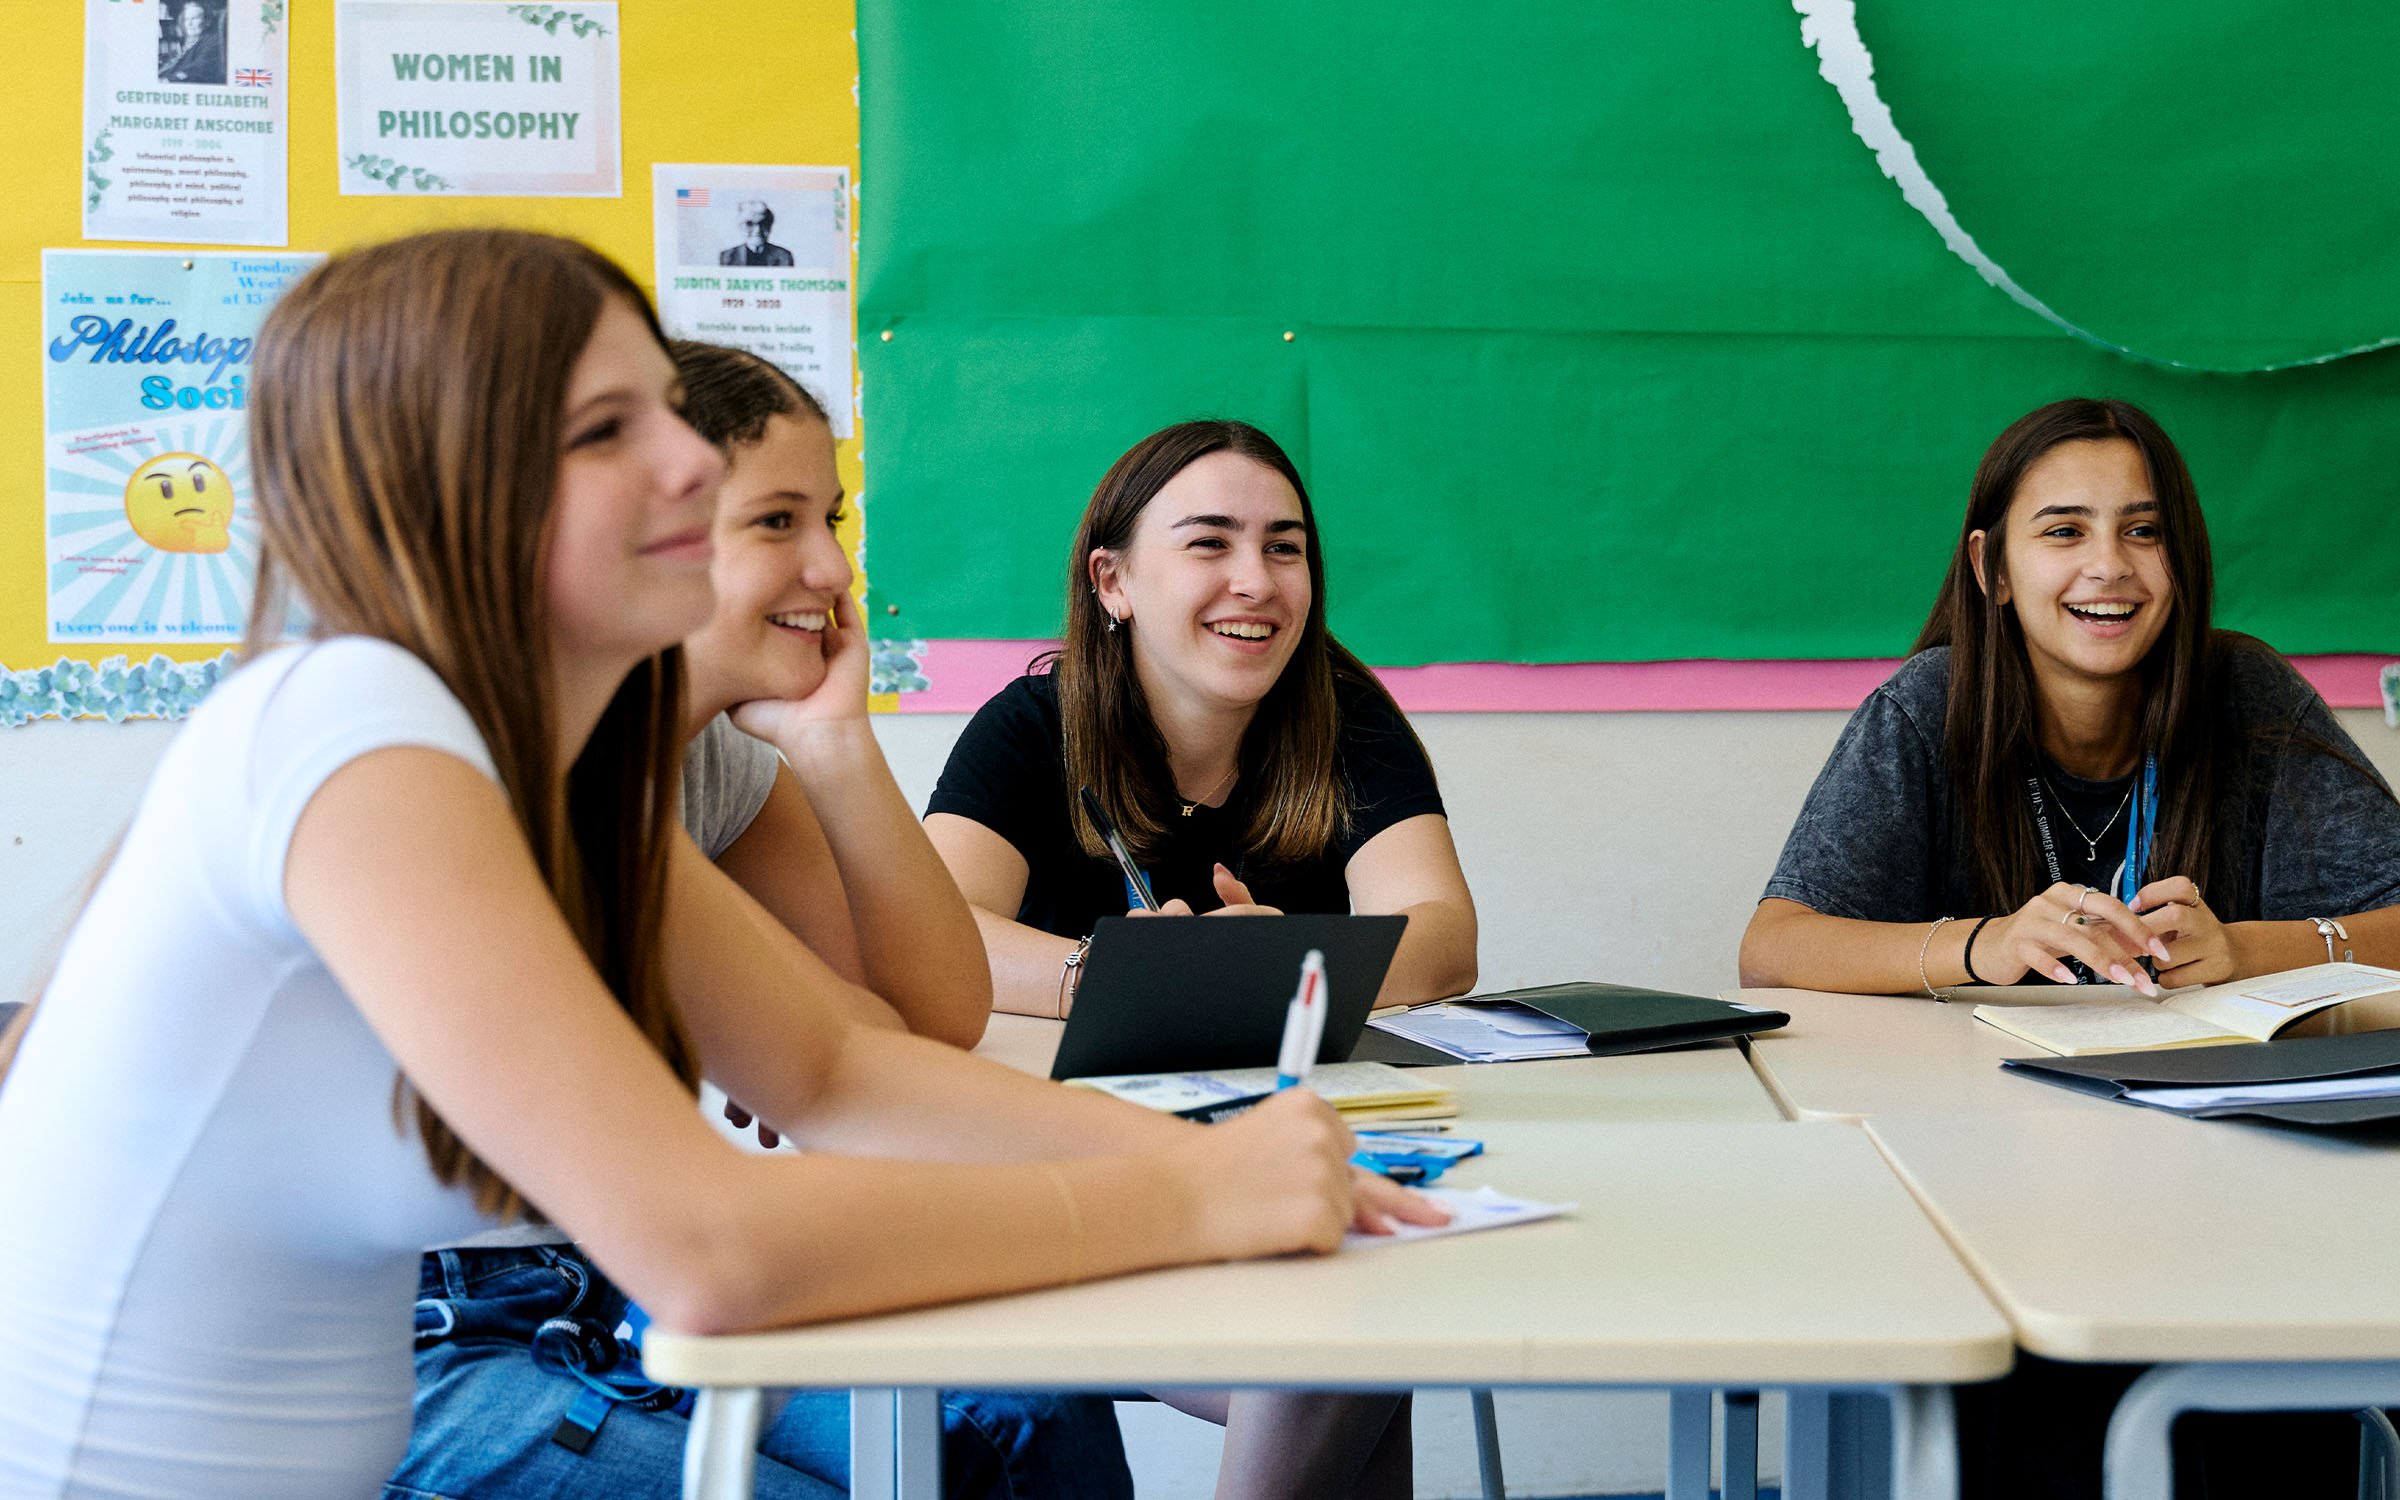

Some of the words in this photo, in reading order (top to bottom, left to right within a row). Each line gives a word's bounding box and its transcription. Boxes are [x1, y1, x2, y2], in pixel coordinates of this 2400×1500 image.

[392, 53, 514, 82] WOMEN
[529, 55, 562, 82] IN
[116, 90, 190, 106] GERTRUDE
[195, 93, 269, 108] ELIZABETH
[111, 116, 189, 131] MARGARET
[195, 119, 274, 134] ANSCOMBE
[378, 110, 579, 139] PHILOSOPHY
[179, 154, 224, 163] philosopher
[130, 181, 172, 189] philosophy
[128, 194, 170, 203] philosophy
[190, 197, 233, 205] philosophy
[171, 210, 200, 218] religion
[674, 277, 720, 290] JUDITH
[726, 279, 774, 291] JARVIS
[780, 279, 848, 292] THOMSON
[60, 293, 95, 305] Join
[106, 296, 125, 304] us
[222, 294, 239, 305] at
[141, 375, 252, 411] Soci
[77, 566, 128, 575] philosophy
[55, 621, 140, 635] Everyone
[144, 621, 158, 632] is
[1181, 805, 1194, 817] R
[2036, 815, 2054, 850] SUMMER
[2046, 849, 2062, 884] SCHOOL
